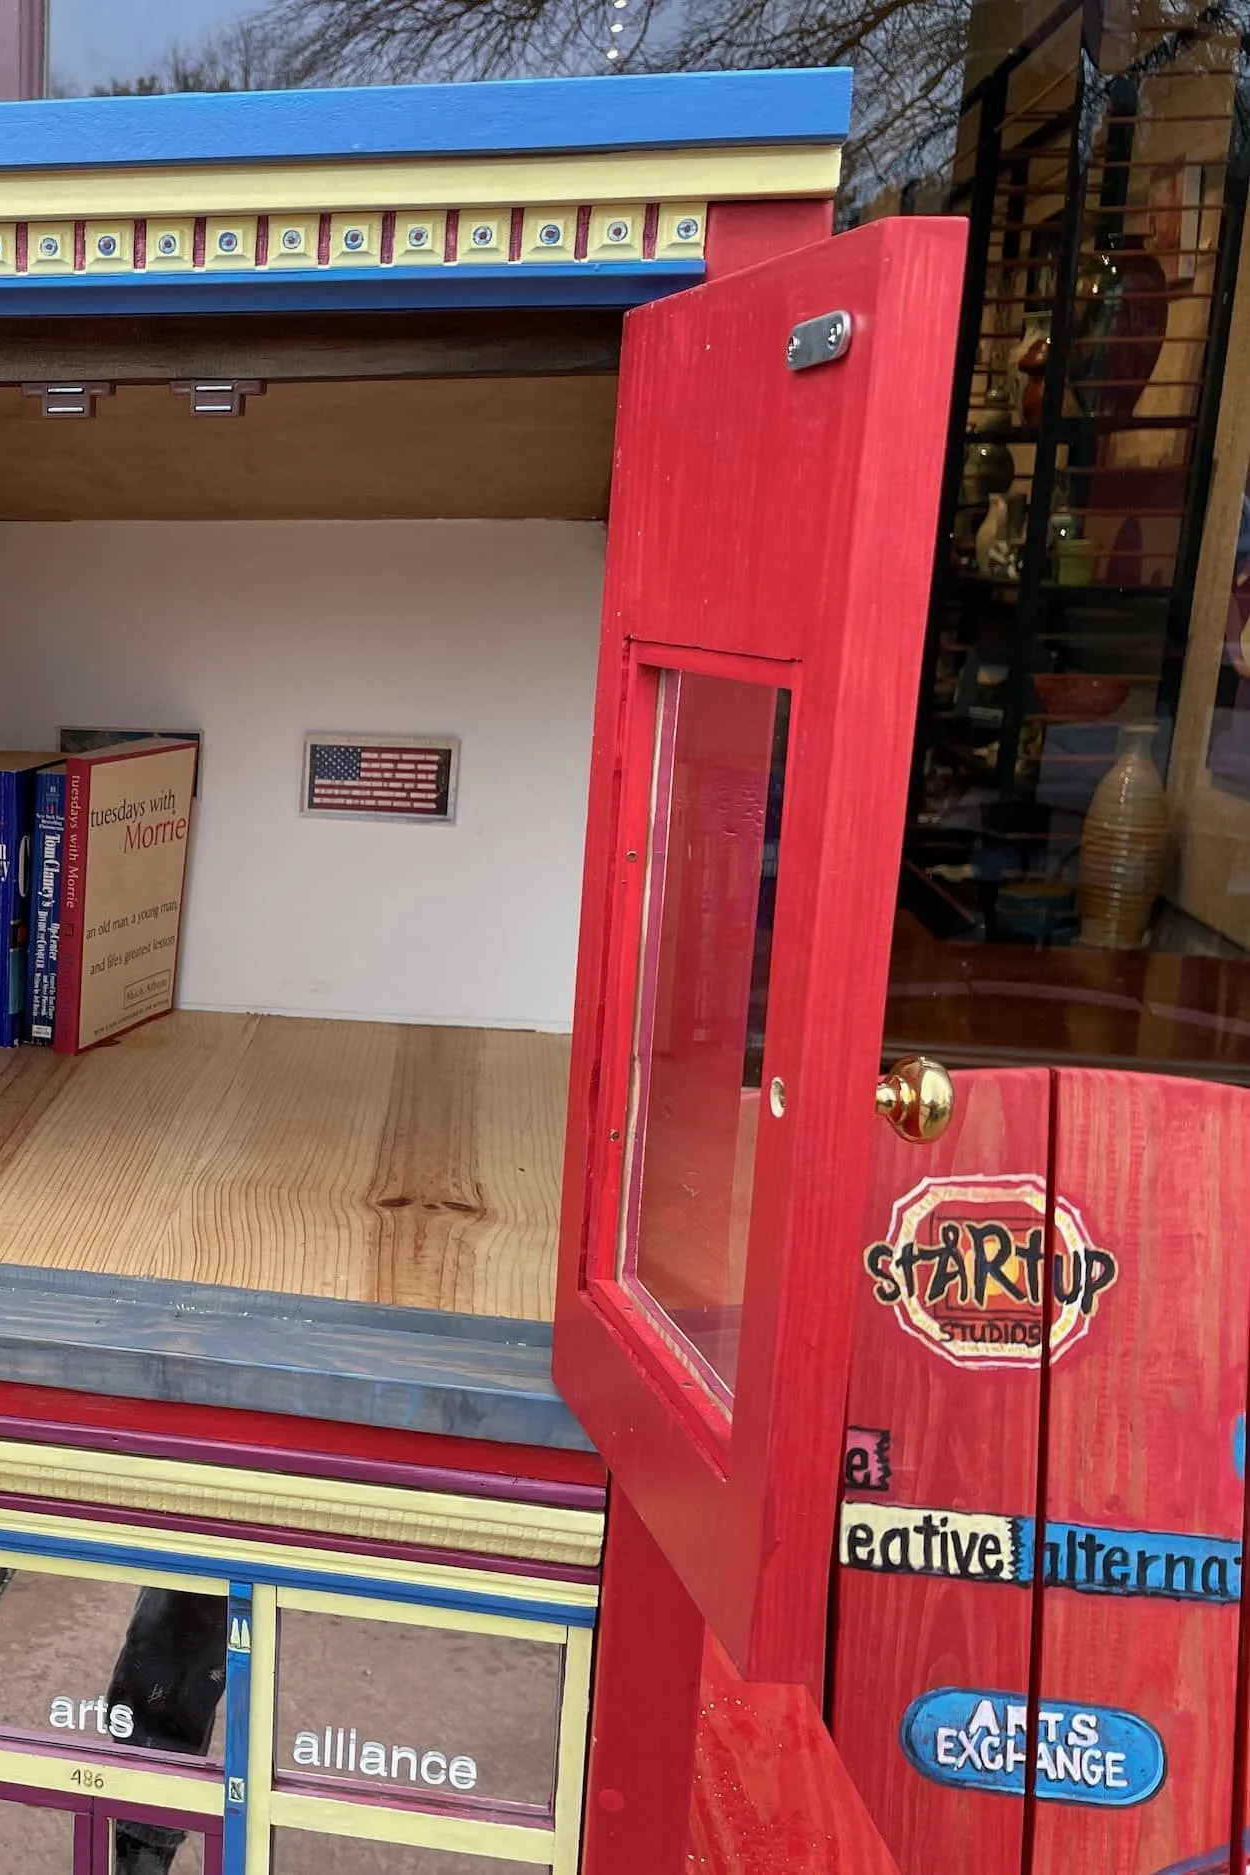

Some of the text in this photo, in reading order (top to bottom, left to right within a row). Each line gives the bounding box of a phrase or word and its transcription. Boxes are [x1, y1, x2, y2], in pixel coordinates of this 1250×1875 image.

[90, 798, 145, 828] tuesdays
[149, 788, 175, 812] with
[44, 834, 61, 859] Tom
[66, 775, 81, 909] tuesdays with Morrie
[123, 816, 187, 854] Morrie
[38, 859, 61, 908] Clancy's
[86, 928, 97, 940] an
[98, 919, 110, 936] old
[138, 907, 160, 926] young
[90, 960, 105, 976] and
[124, 942, 151, 966] greatest
[153, 935, 175, 951] lesson
[846, 1514, 1004, 1577] eative
[49, 1695, 135, 1739] arts
[293, 1725, 478, 1791] alliance
[70, 1768, 105, 1790] 486
